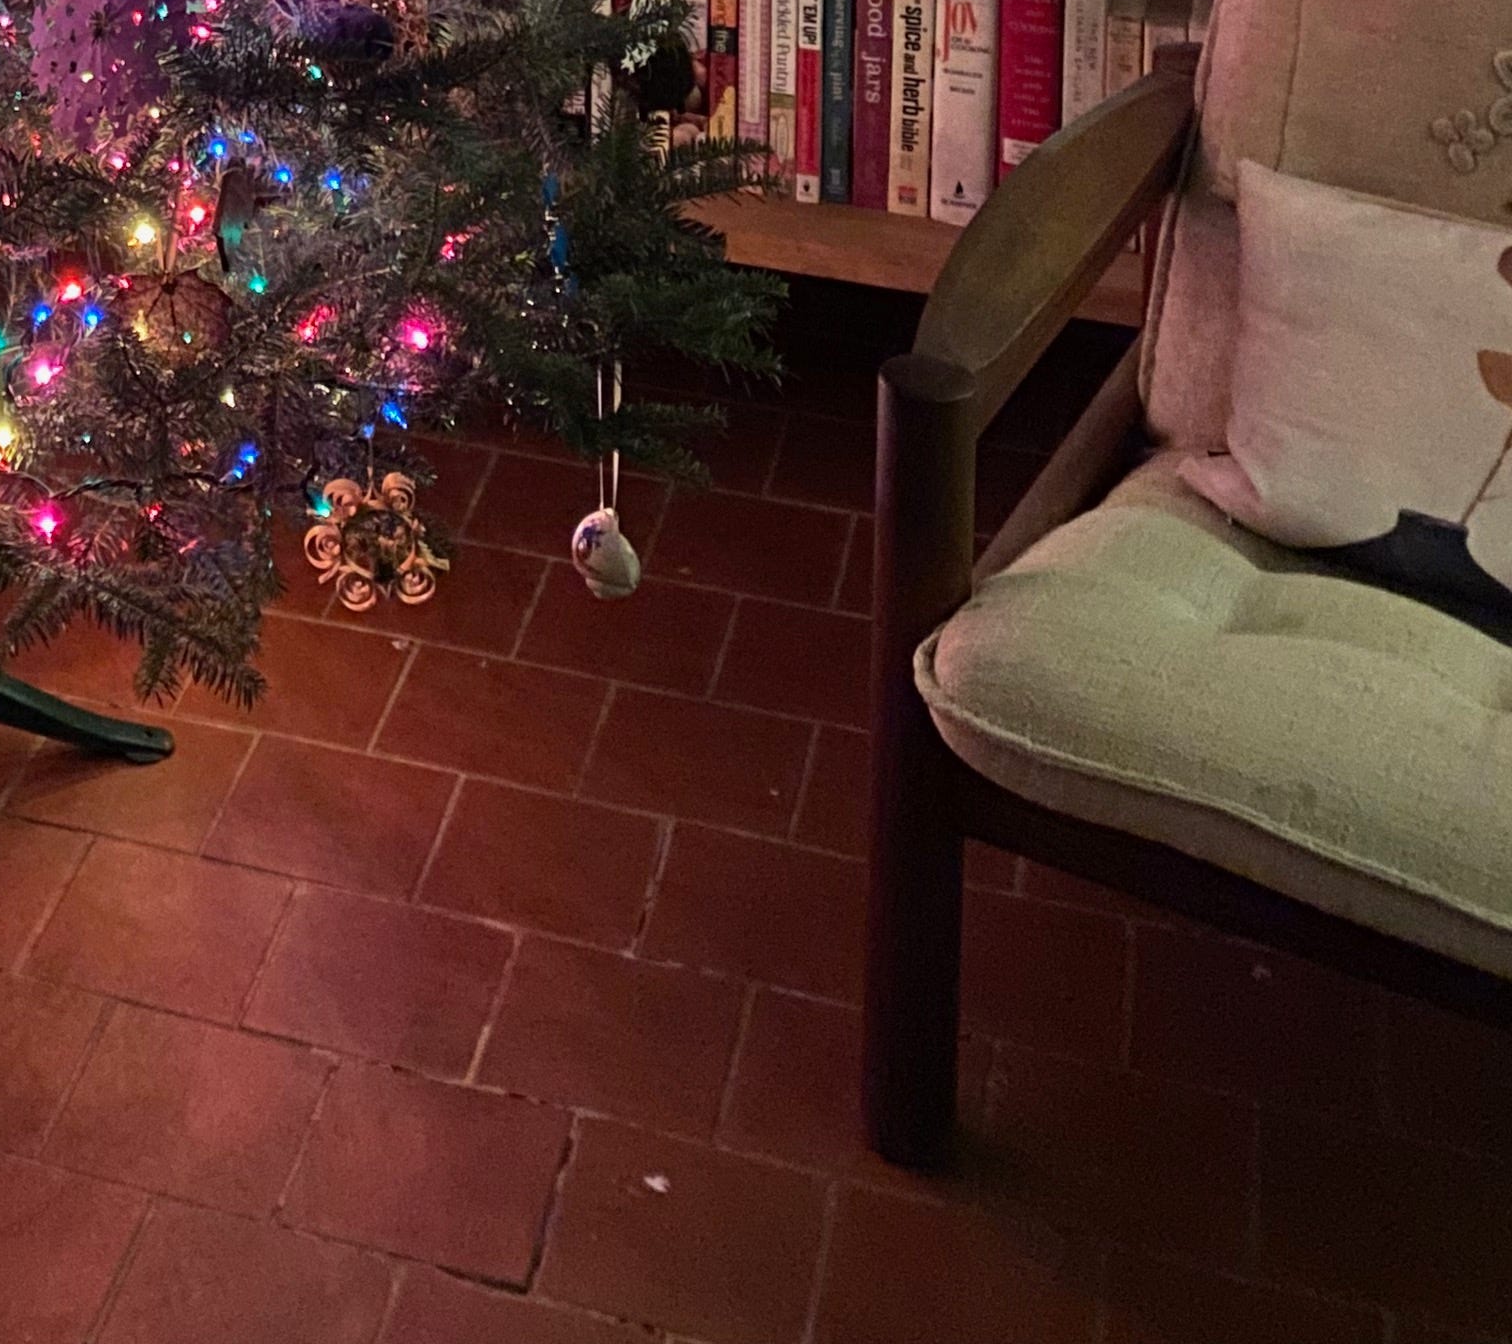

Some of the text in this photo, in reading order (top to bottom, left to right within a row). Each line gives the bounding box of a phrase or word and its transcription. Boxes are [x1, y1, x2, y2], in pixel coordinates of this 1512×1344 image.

[715, 30, 729, 52] the
[803, 26, 817, 45] UP!
[900, 5, 926, 52] spice
[774, 43, 794, 93] Pantry
[861, 51, 884, 104] jars
[904, 53, 917, 74] and
[902, 76, 926, 116] herb
[900, 118, 918, 152] bible
